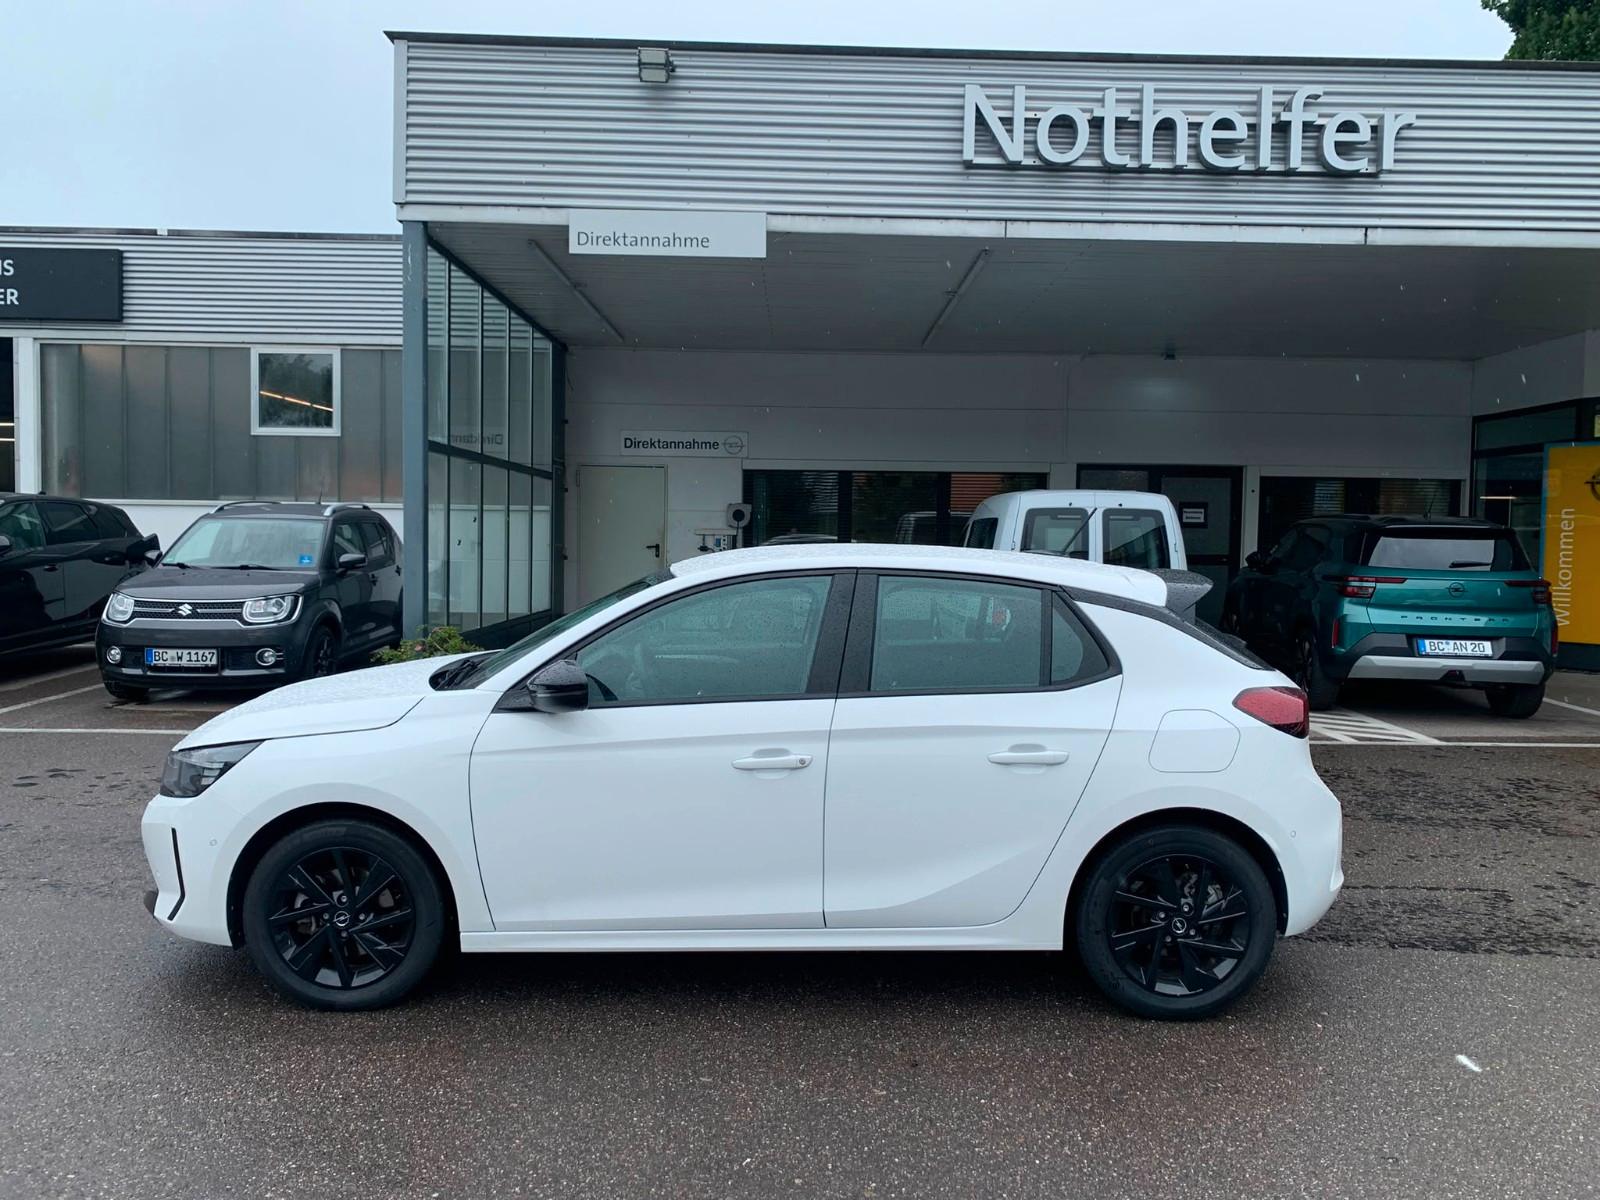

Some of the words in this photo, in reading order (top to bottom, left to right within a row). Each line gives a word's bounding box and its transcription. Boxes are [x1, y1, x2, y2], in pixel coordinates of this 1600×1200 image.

[962, 83, 1417, 174] Nothelfer
[576, 231, 710, 248] Direktannahme
[623, 437, 720, 450] Direktannahme
[1551, 507, 1575, 627] Willkommen
[1428, 641, 1445, 652] BC
[1452, 642, 1468, 652] AN
[1470, 642, 1486, 653] 20
[153, 651, 168, 662] BC
[176, 651, 184, 662] W
[186, 651, 216, 662] 1167
